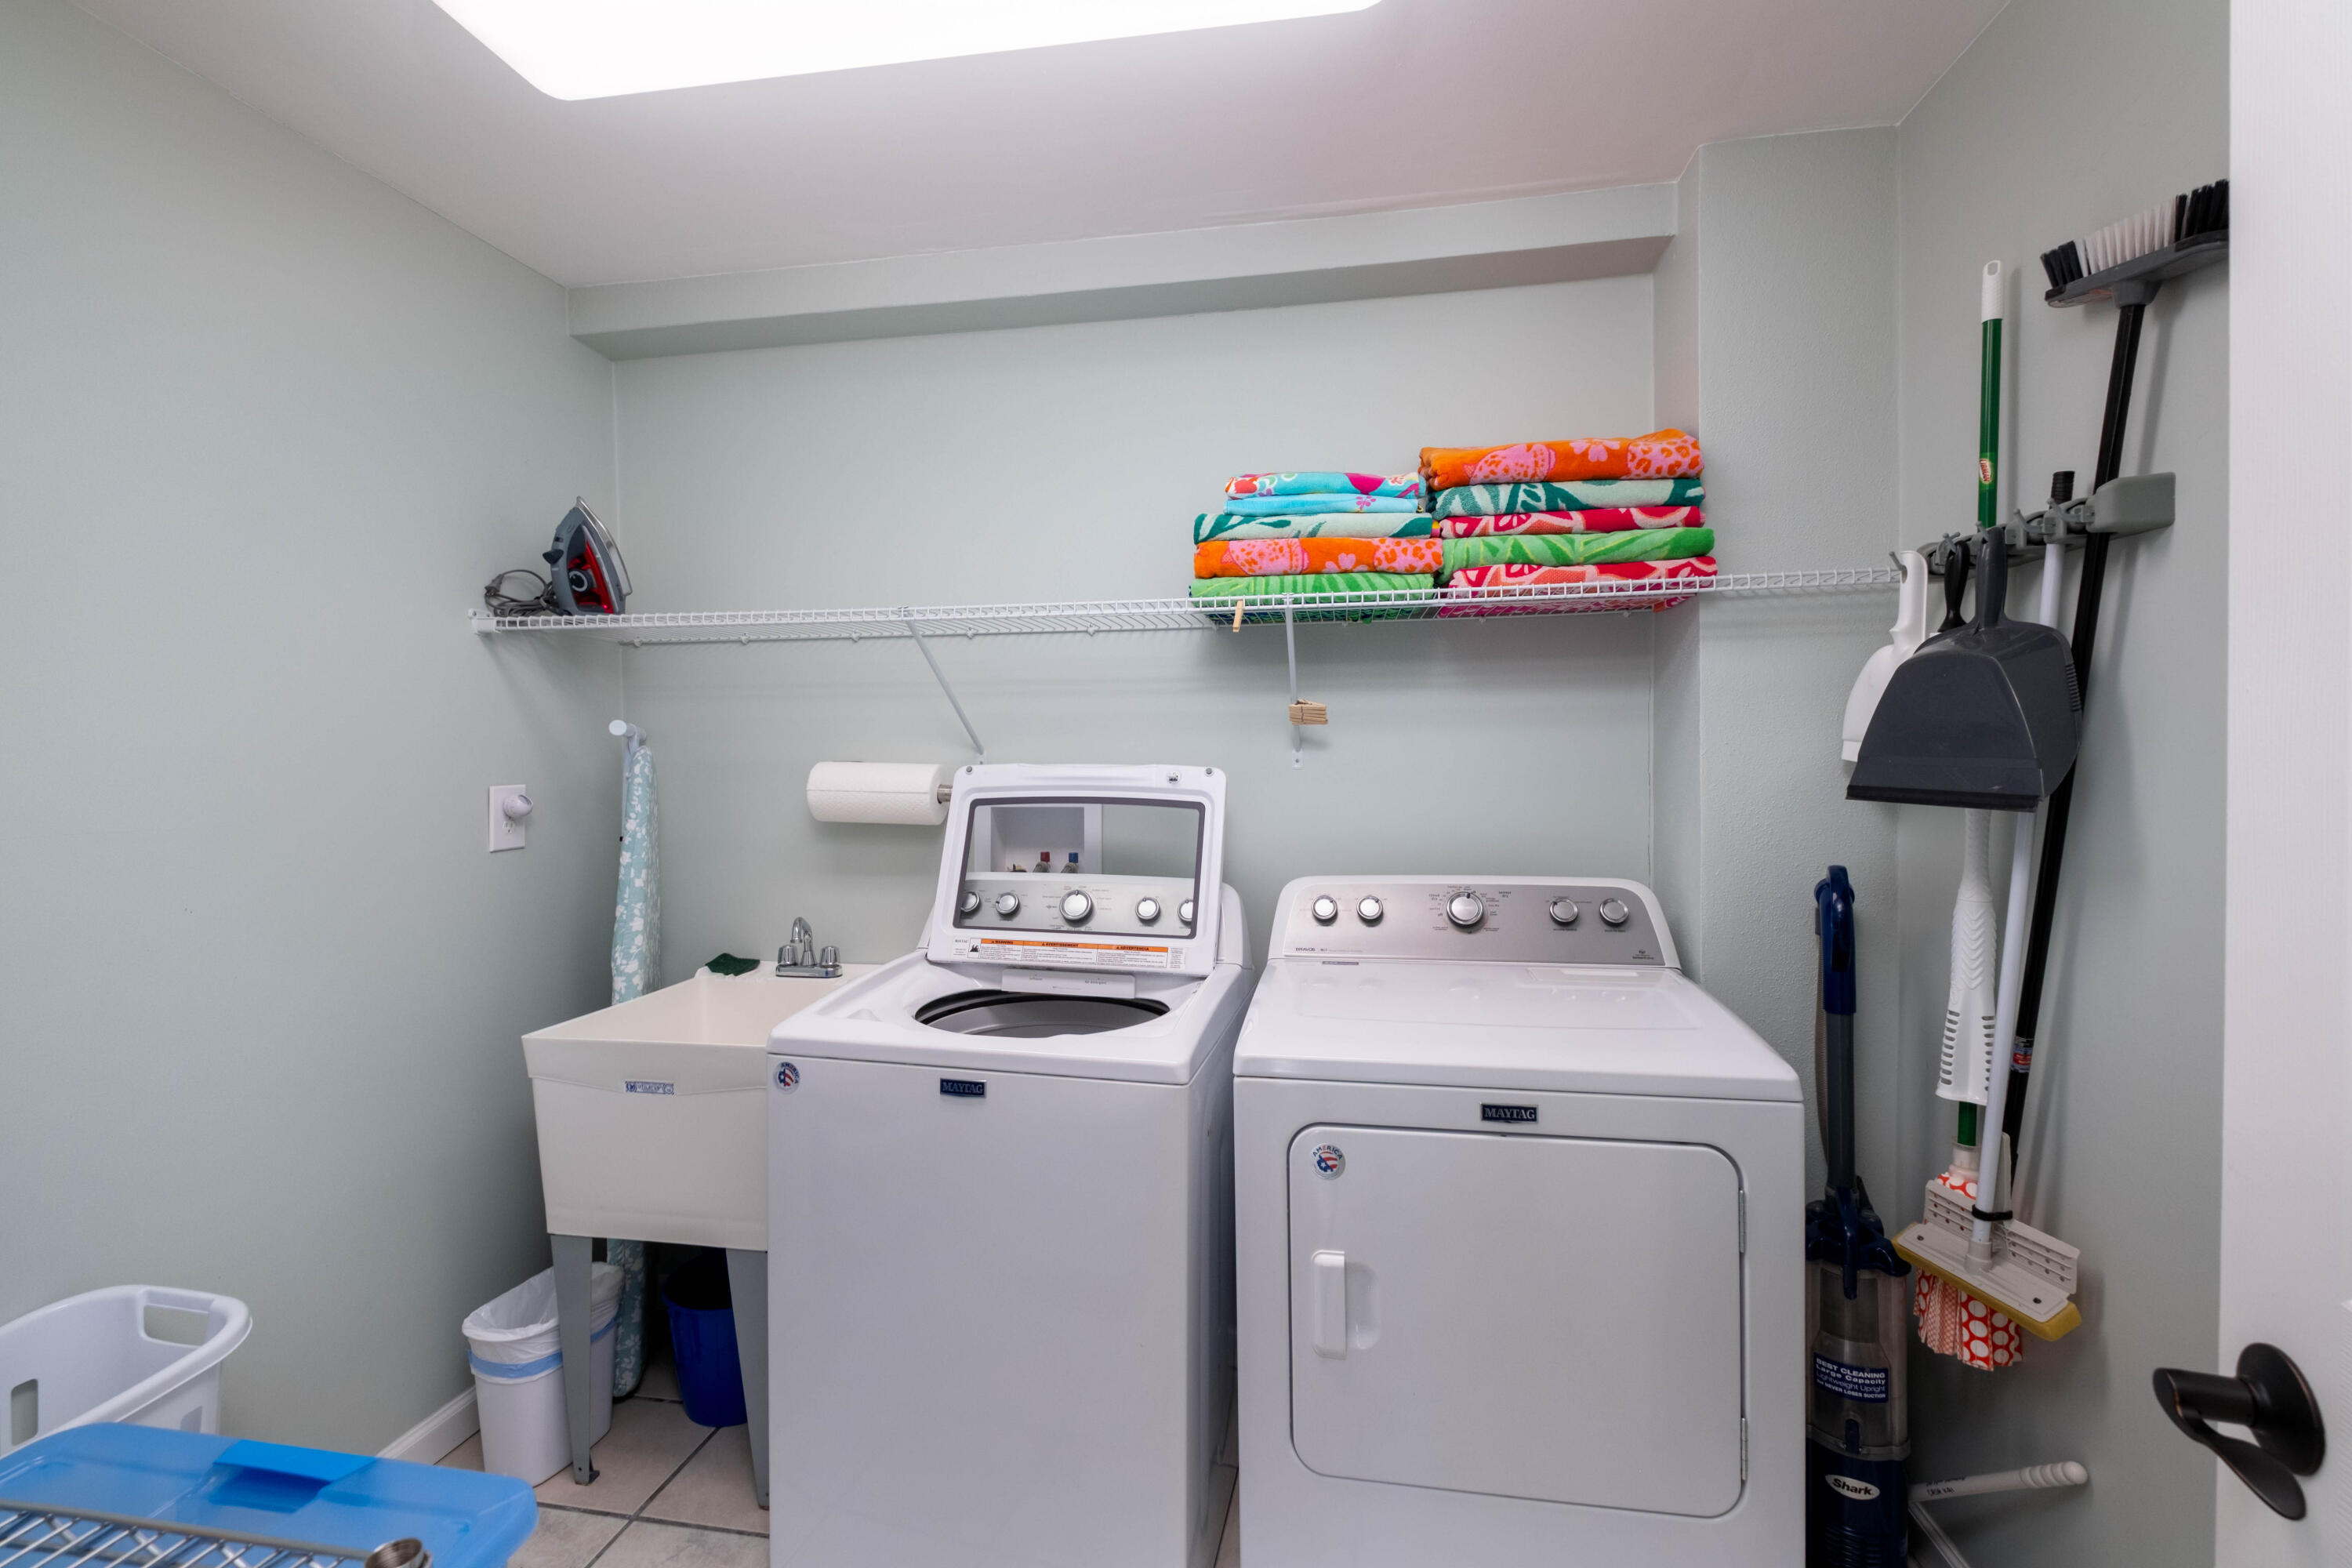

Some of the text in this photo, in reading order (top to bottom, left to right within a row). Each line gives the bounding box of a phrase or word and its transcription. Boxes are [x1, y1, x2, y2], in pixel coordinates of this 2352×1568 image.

[942, 1082, 984, 1094] MAYTAG
[1484, 1107, 1536, 1120] MAYTAG
[1312, 1145, 1343, 1160] AMERICA
[1816, 1357, 1886, 1378] BEST CLEANING
[1816, 1364, 1886, 1386] Large Capacity
[1816, 1370, 1886, 1394] Lightweight Upright
[1824, 1382, 1843, 1393] NEVER
[1831, 1478, 1872, 1496] Shark
